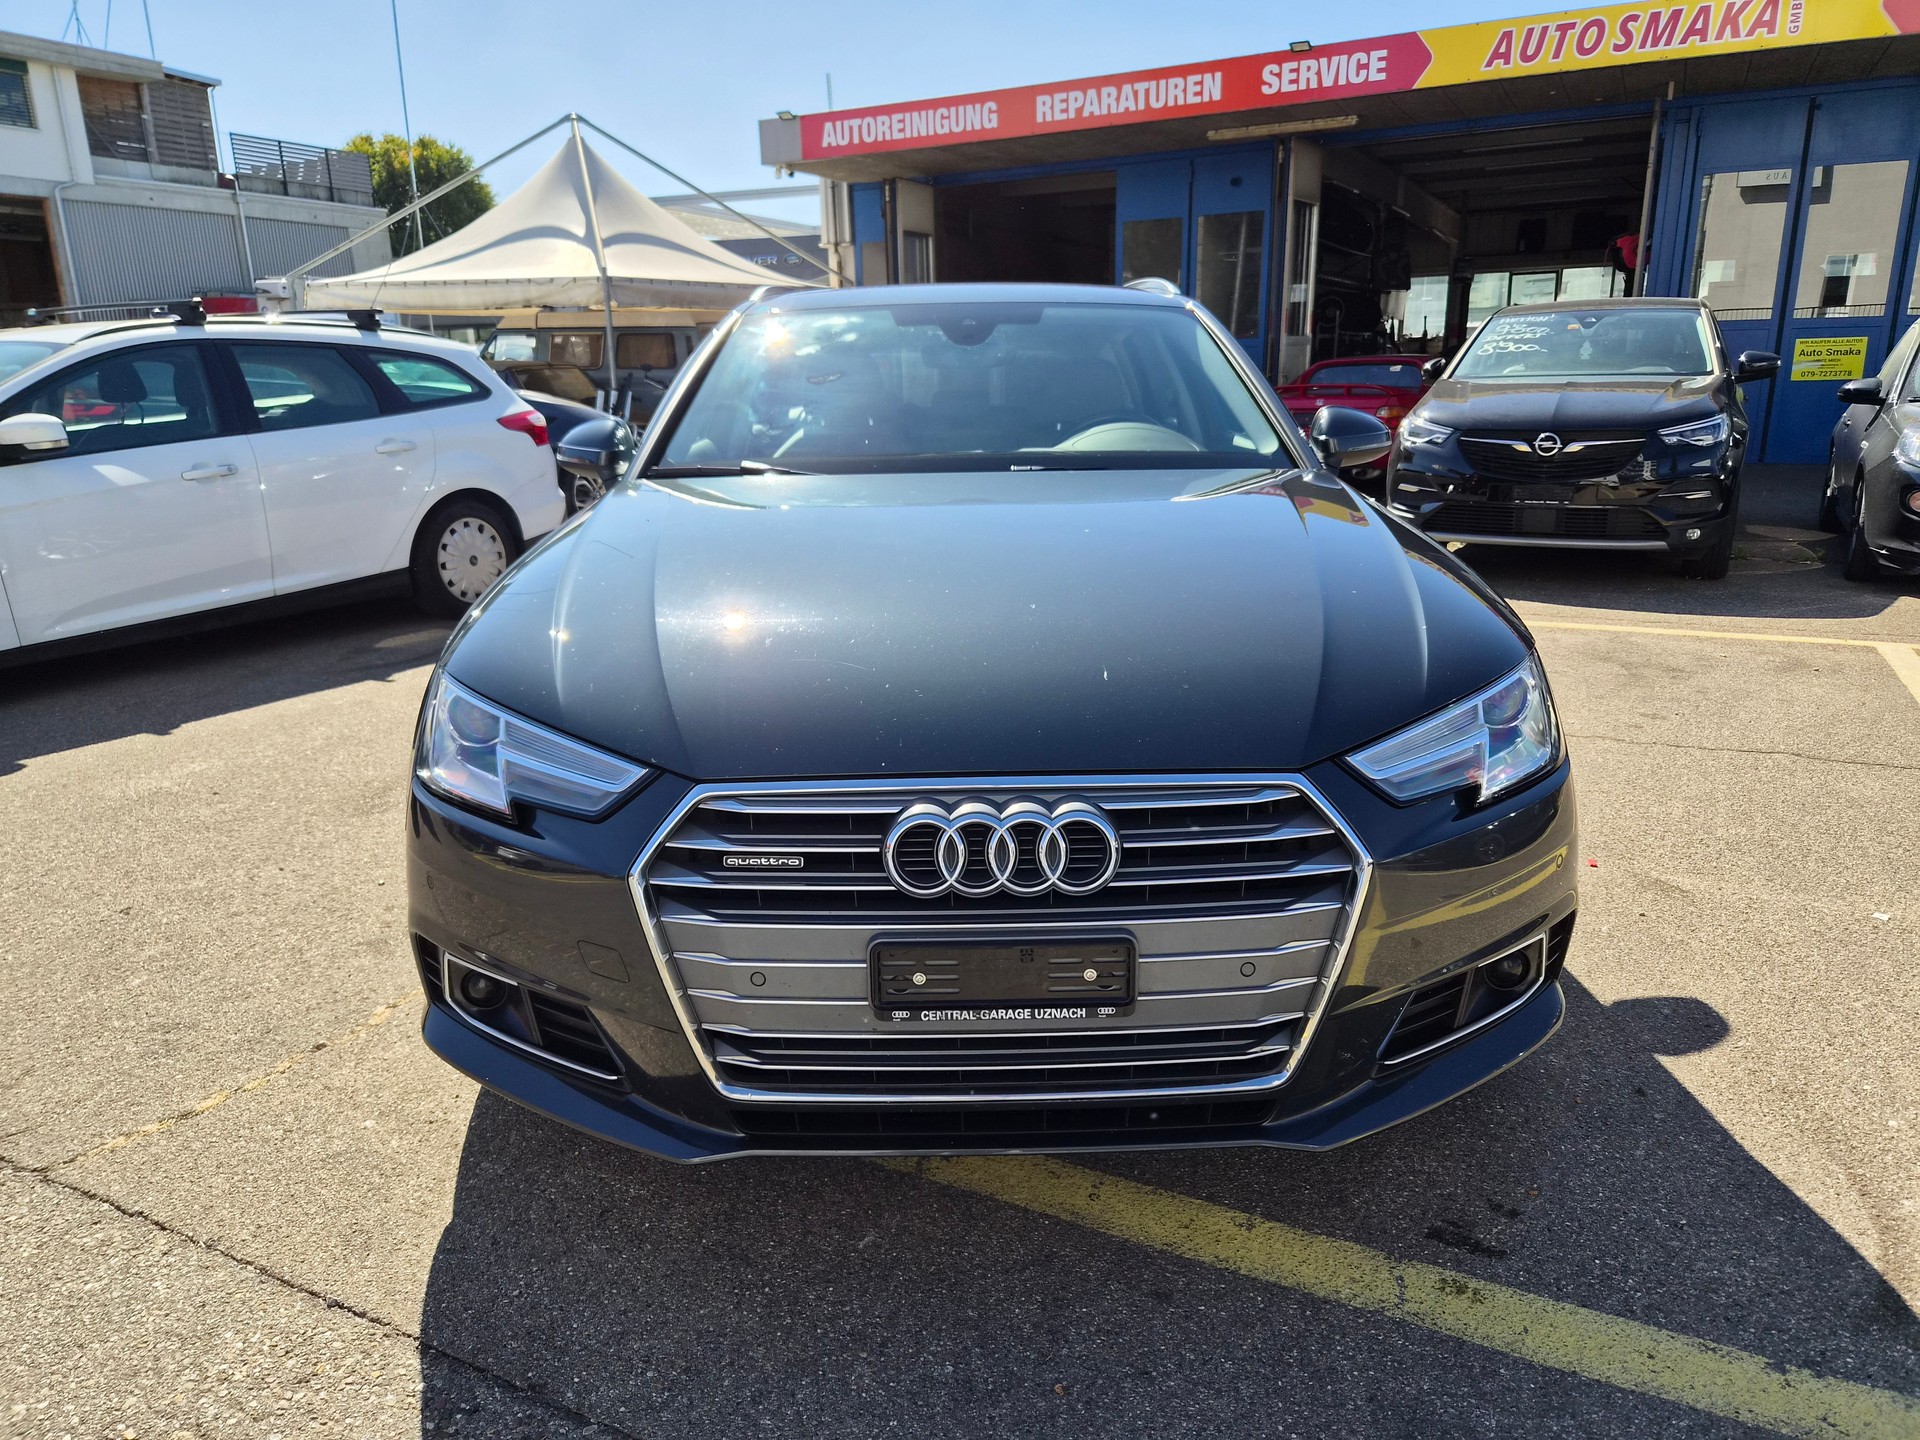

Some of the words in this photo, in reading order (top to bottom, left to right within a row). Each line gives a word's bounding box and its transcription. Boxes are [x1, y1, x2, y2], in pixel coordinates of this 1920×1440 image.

[1482, 16, 1608, 70] AUTO
[1611, 0, 1782, 53] SMAKA
[1788, 0, 1803, 34] GMB
[1260, 49, 1388, 95] SERVICE
[1036, 72, 1222, 123] REPARATUREN
[822, 102, 998, 148] AUTOREINIGUNG
[1799, 349, 1823, 357] Auto
[1826, 347, 1861, 356] Smaka
[727, 857, 799, 866] quattro
[920, 1008, 1032, 1021] CENTRAL-GARAGE
[1034, 1007, 1086, 1019] UZNACH
